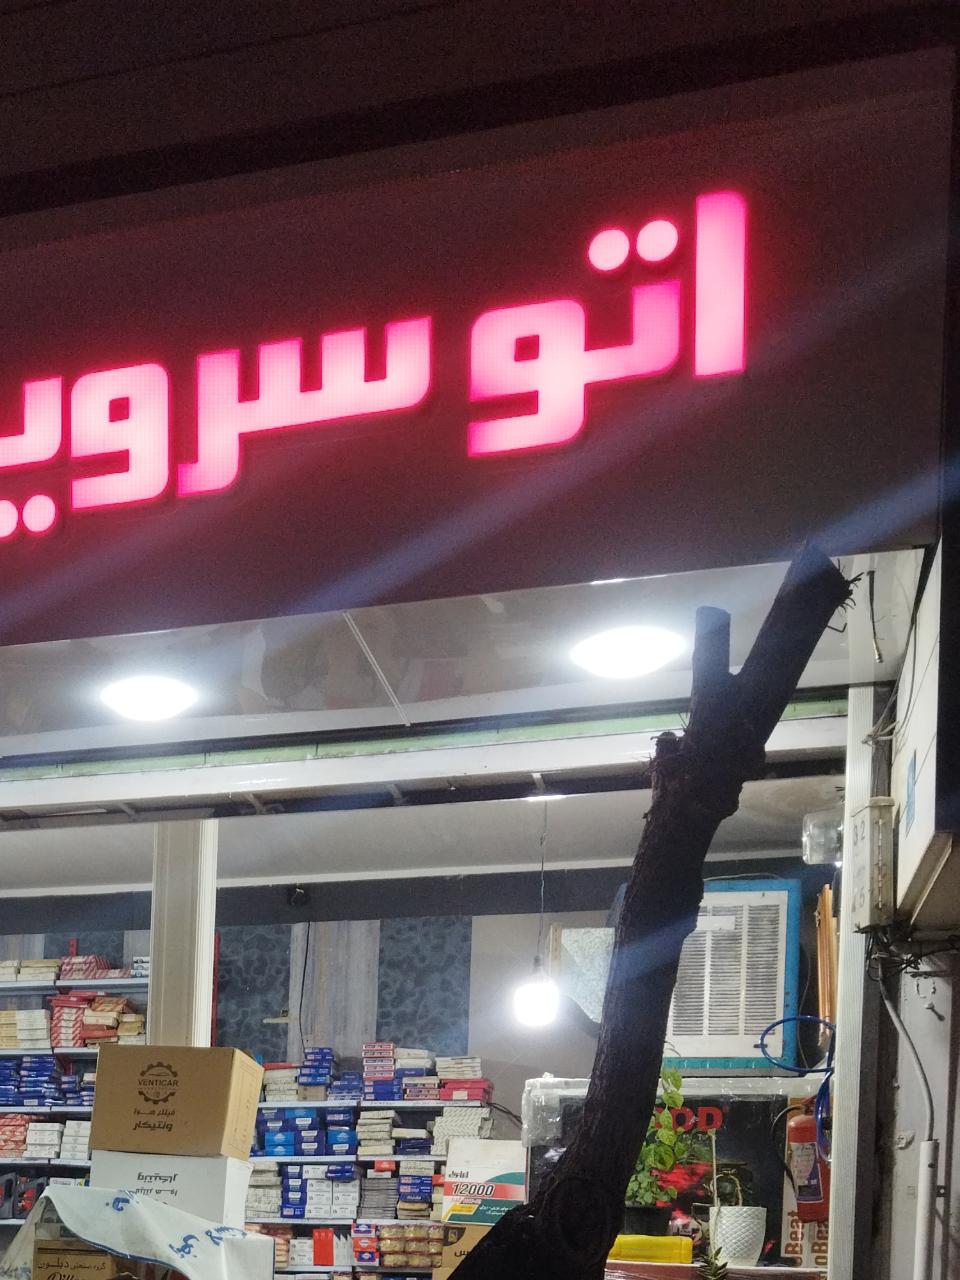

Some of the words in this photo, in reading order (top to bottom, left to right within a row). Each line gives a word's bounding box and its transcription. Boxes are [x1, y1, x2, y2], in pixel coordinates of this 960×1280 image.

[464, 188, 750, 460] اتو
[138, 1079, 180, 1088] VENTICAR
[133, 1121, 174, 1132] ونتیکار
[452, 1183, 495, 1196] 12000
